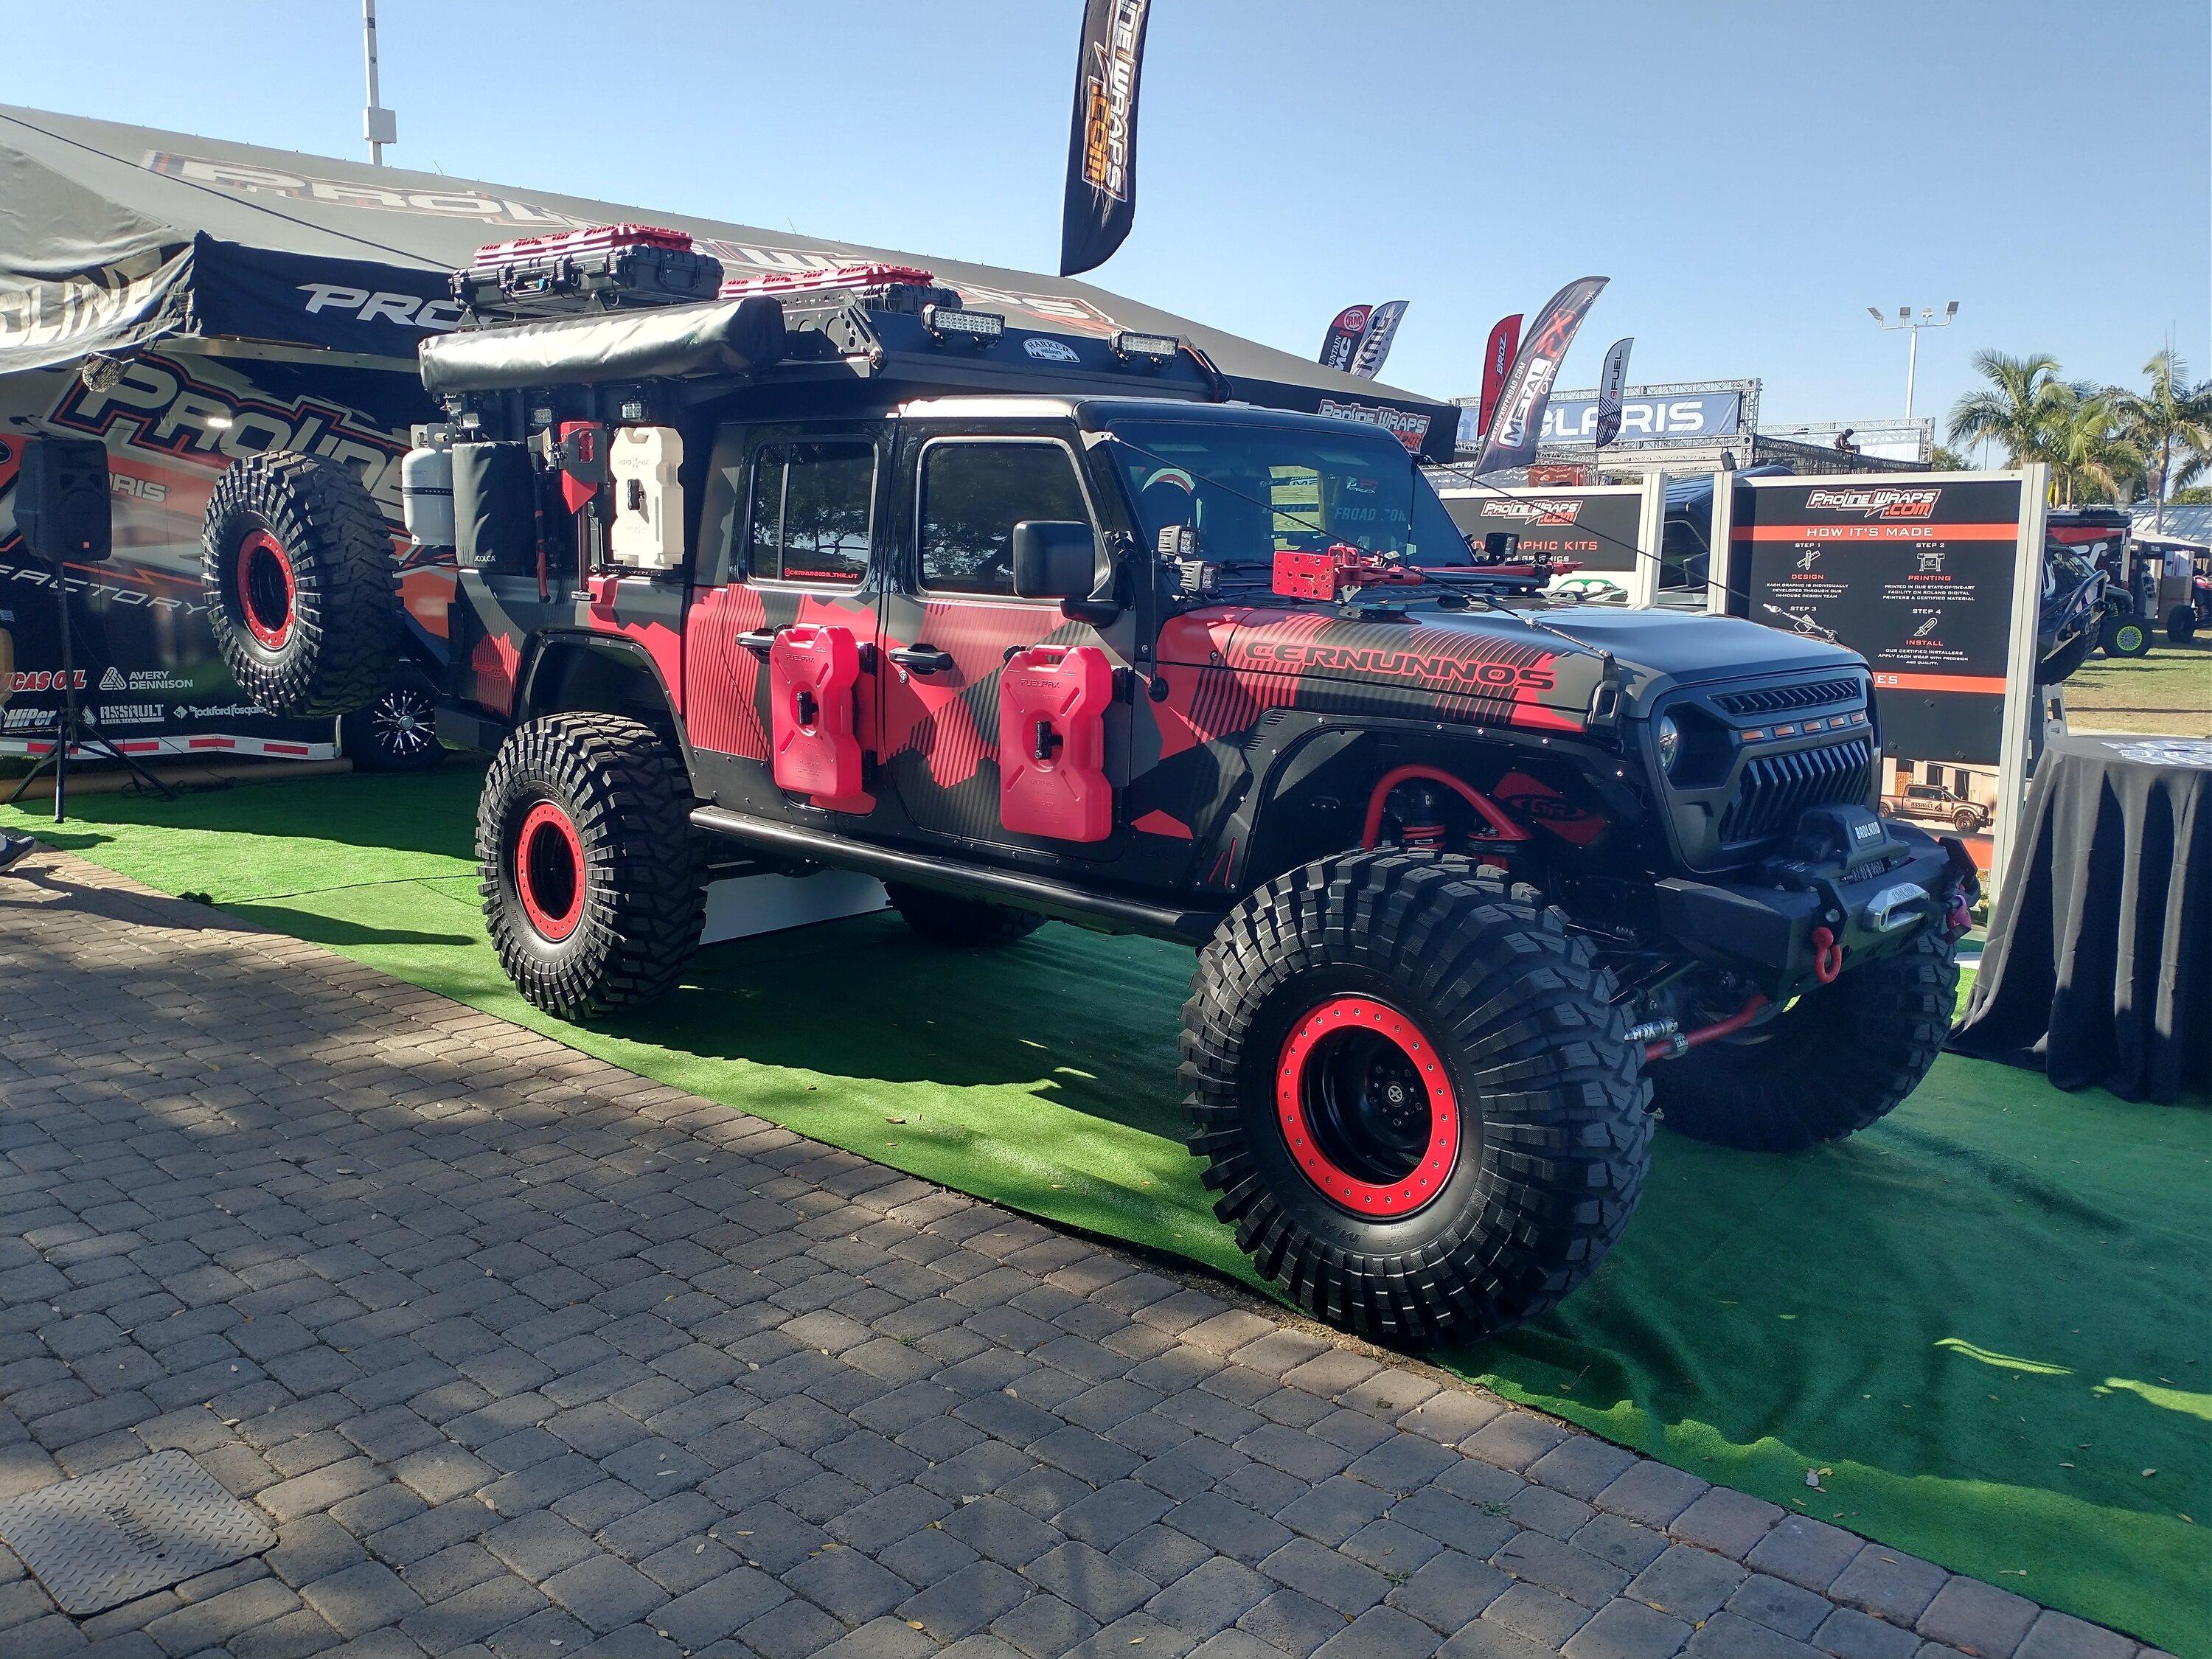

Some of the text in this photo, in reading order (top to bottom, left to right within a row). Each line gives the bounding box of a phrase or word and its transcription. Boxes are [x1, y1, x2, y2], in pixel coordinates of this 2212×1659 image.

[1088, 85, 1110, 181] .COM
[1105, 57, 1133, 194] WRAPS
[0, 248, 467, 348] OLINE PRO
[1027, 341, 1069, 353] HARKER
[1357, 316, 1390, 371] KMC
[1328, 335, 1342, 369] OUNTAIN
[1611, 349, 1622, 391] FUEL
[1503, 363, 1548, 442] METAL
[1377, 411, 1427, 434] WRAPS
[109, 473, 165, 502] RIS
[1811, 492, 1935, 506] PROLINE WRAPS
[1485, 501, 1579, 515] PROLINE WRAPS
[1885, 503, 1929, 516] .COM
[1540, 512, 1574, 524] .COM
[1806, 527, 1933, 537] HOW IT'S MADE
[1564, 540, 1598, 551] KITS
[1244, 640, 1557, 691] CERNUNNOS
[129, 670, 170, 681] AVERY
[1877, 675, 1898, 684] ES
[129, 679, 193, 690] DENNISON
[1020, 678, 1060, 689] FUELPAX
[4, 709, 57, 728] HiPer
[100, 704, 164, 719] ASSAULT
[189, 705, 230, 719] Rockford
[1854, 821, 1881, 840] BADLAND
